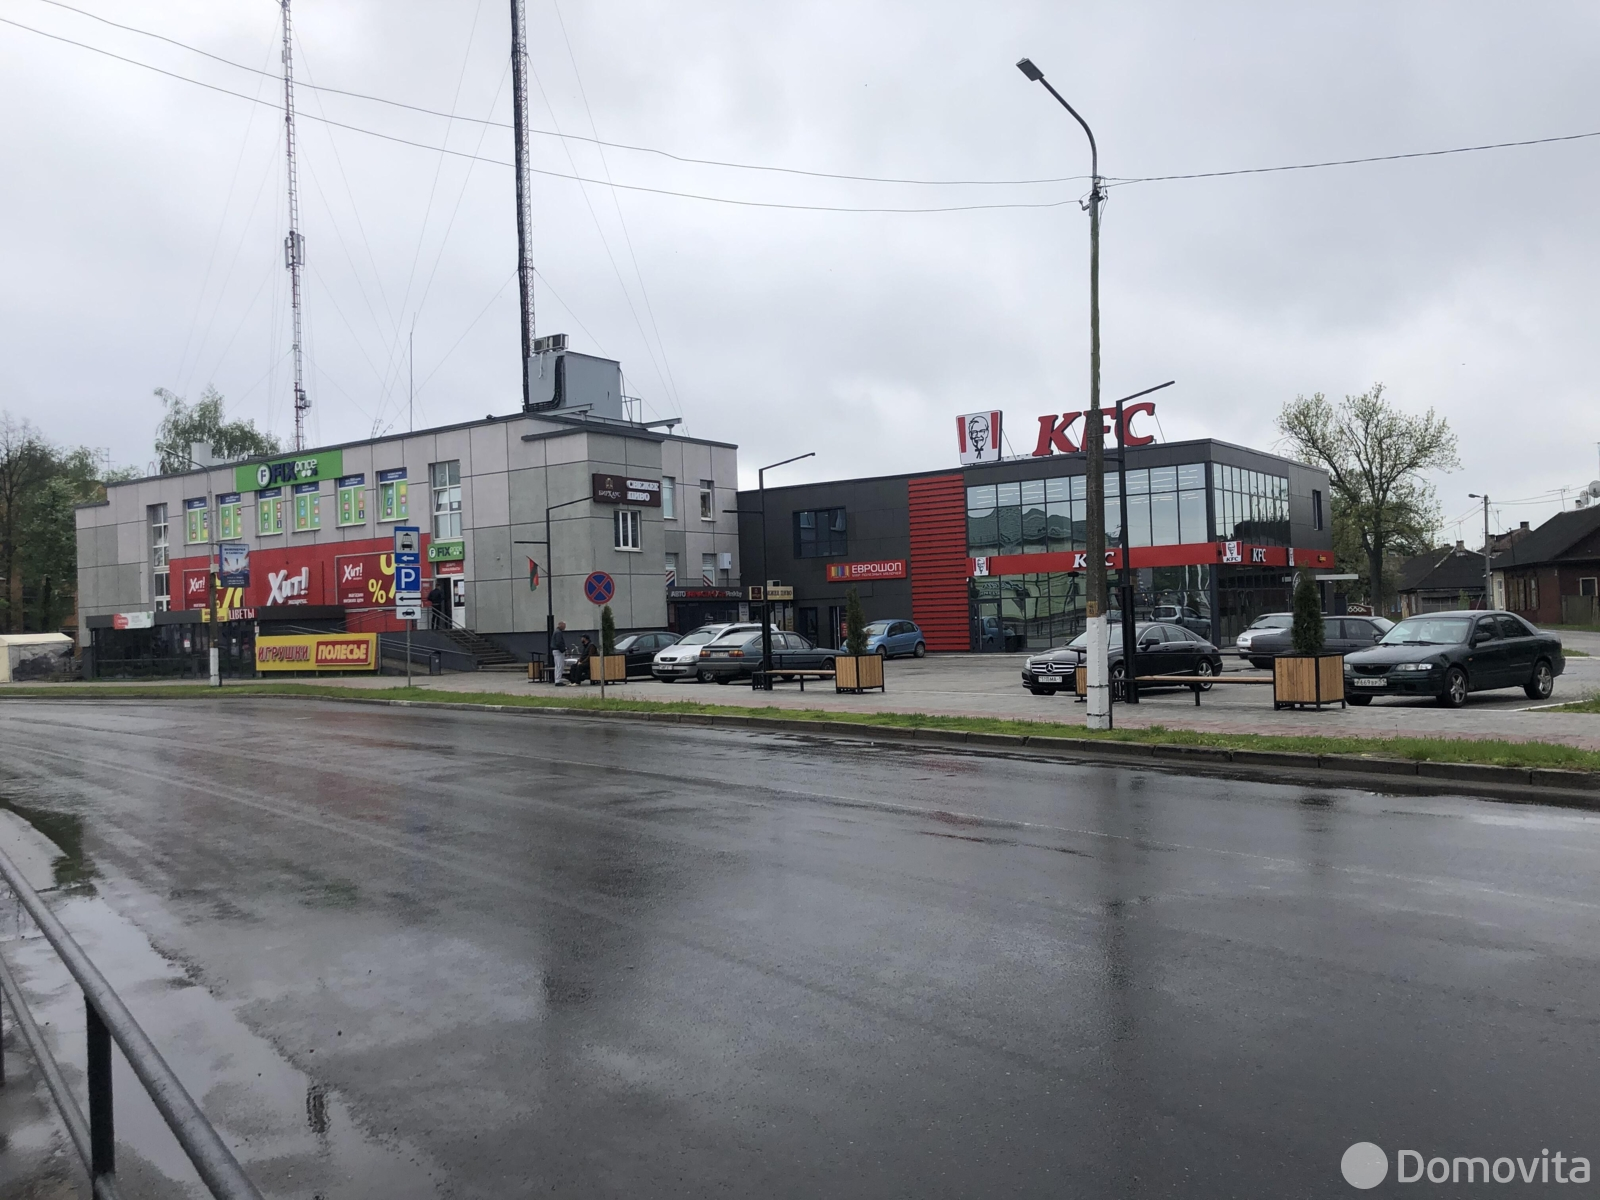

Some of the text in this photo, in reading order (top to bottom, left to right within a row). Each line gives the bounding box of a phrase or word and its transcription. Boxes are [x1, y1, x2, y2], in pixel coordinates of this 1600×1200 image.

[1032, 402, 1155, 457] KFC
[271, 461, 298, 484] FIX
[626, 491, 650, 501] ПИВО
[437, 547, 451, 557] FIX
[1072, 552, 1115, 569] KC
[1252, 548, 1267, 562] KFC
[342, 562, 363, 583] Хит!
[852, 562, 902, 574] ЕВРОШОП
[188, 576, 206, 595] Хит!
[266, 567, 309, 607] Хит!
[401, 569, 416, 589] P
[228, 608, 255, 620] ЦВЕТЫ
[258, 644, 367, 663] ИГРУШКИ ПОЛЕСЬЕ
